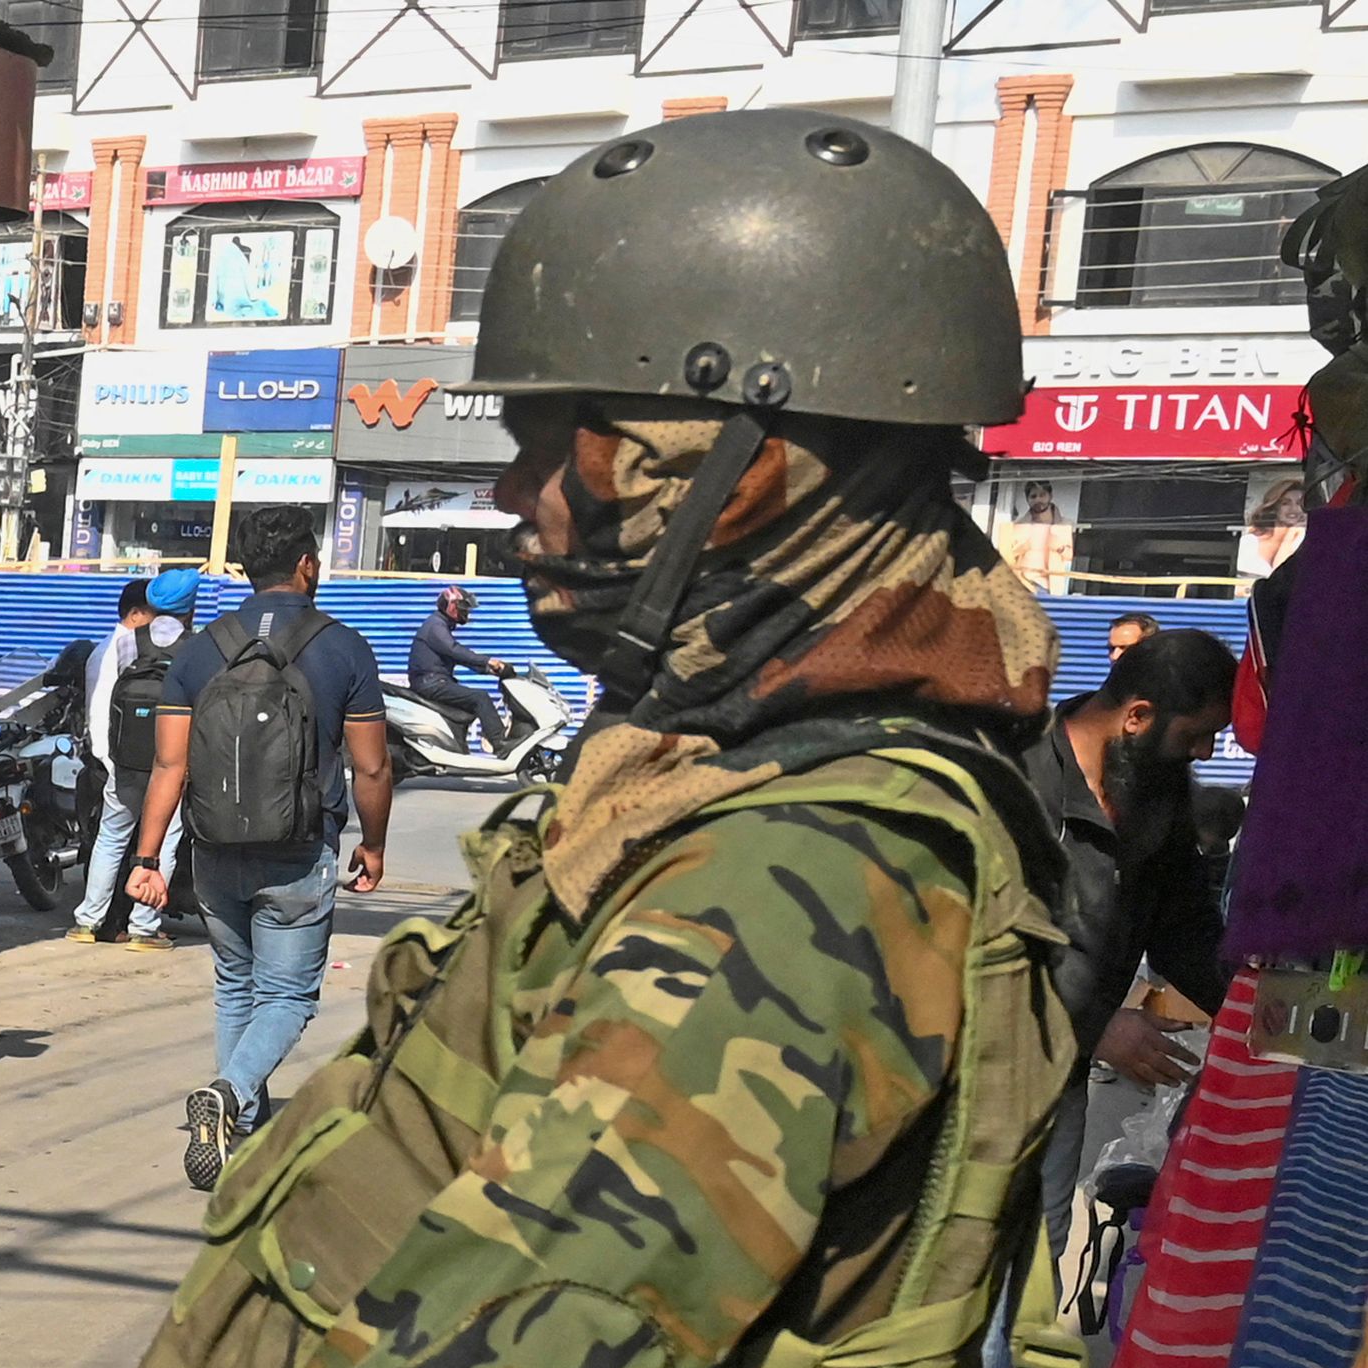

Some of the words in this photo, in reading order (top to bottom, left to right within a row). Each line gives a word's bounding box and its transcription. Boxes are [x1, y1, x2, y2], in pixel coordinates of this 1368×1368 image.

[181, 170, 247, 192] KASHMIR
[252, 167, 281, 188] ART
[285, 165, 334, 188] BAZAR
[95, 383, 190, 405] PHILIPS
[218, 379, 320, 401] LLOYD
[1116, 394, 1271, 431] TITAN
[100, 473, 163, 484] DAIKIN
[255, 472, 322, 486] DAIKIN
[76, 500, 93, 544] OYD
